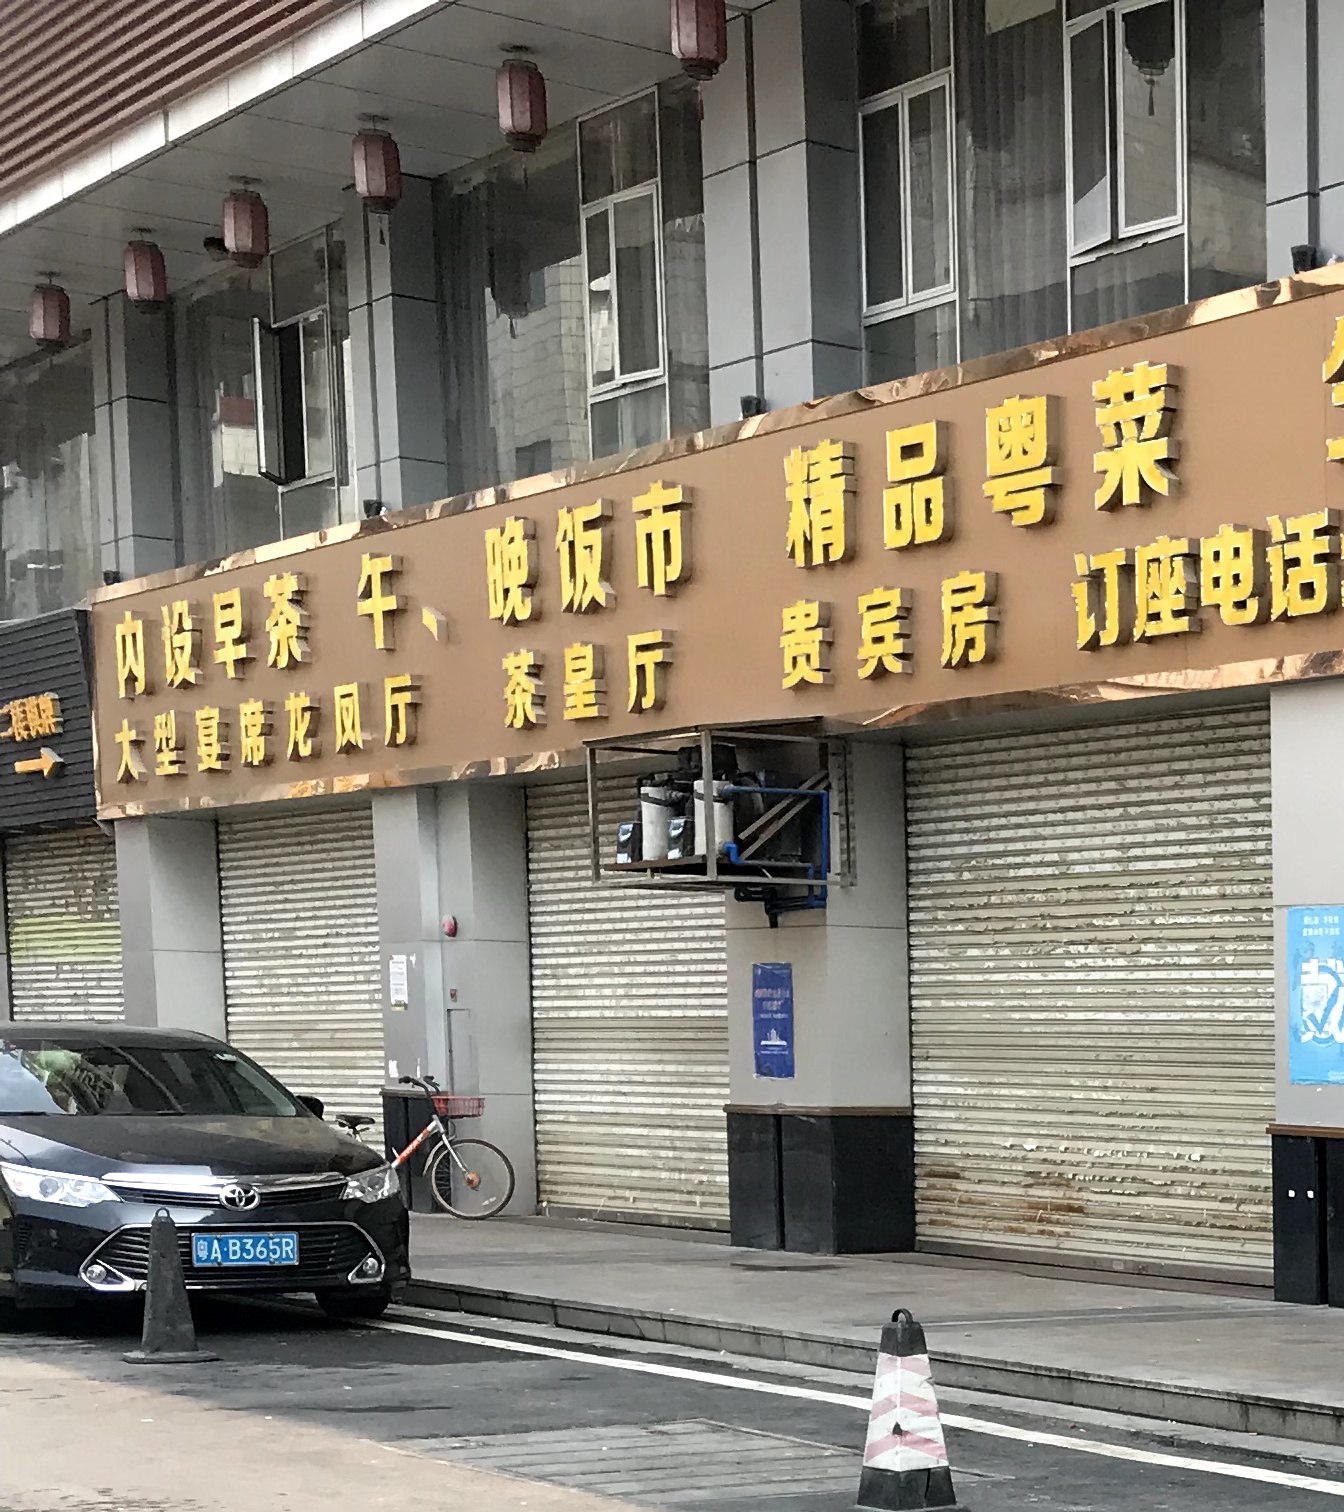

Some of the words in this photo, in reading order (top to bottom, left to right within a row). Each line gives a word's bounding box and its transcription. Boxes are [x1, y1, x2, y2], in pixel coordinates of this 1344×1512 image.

[115, 572, 309, 699] 内设早茶
[784, 361, 1179, 569] 精品粤菜
[114, 673, 418, 783] 大型宴席龙凤厅
[503, 629, 672, 729] 茶皇厅
[780, 569, 998, 690] 贵宾房
